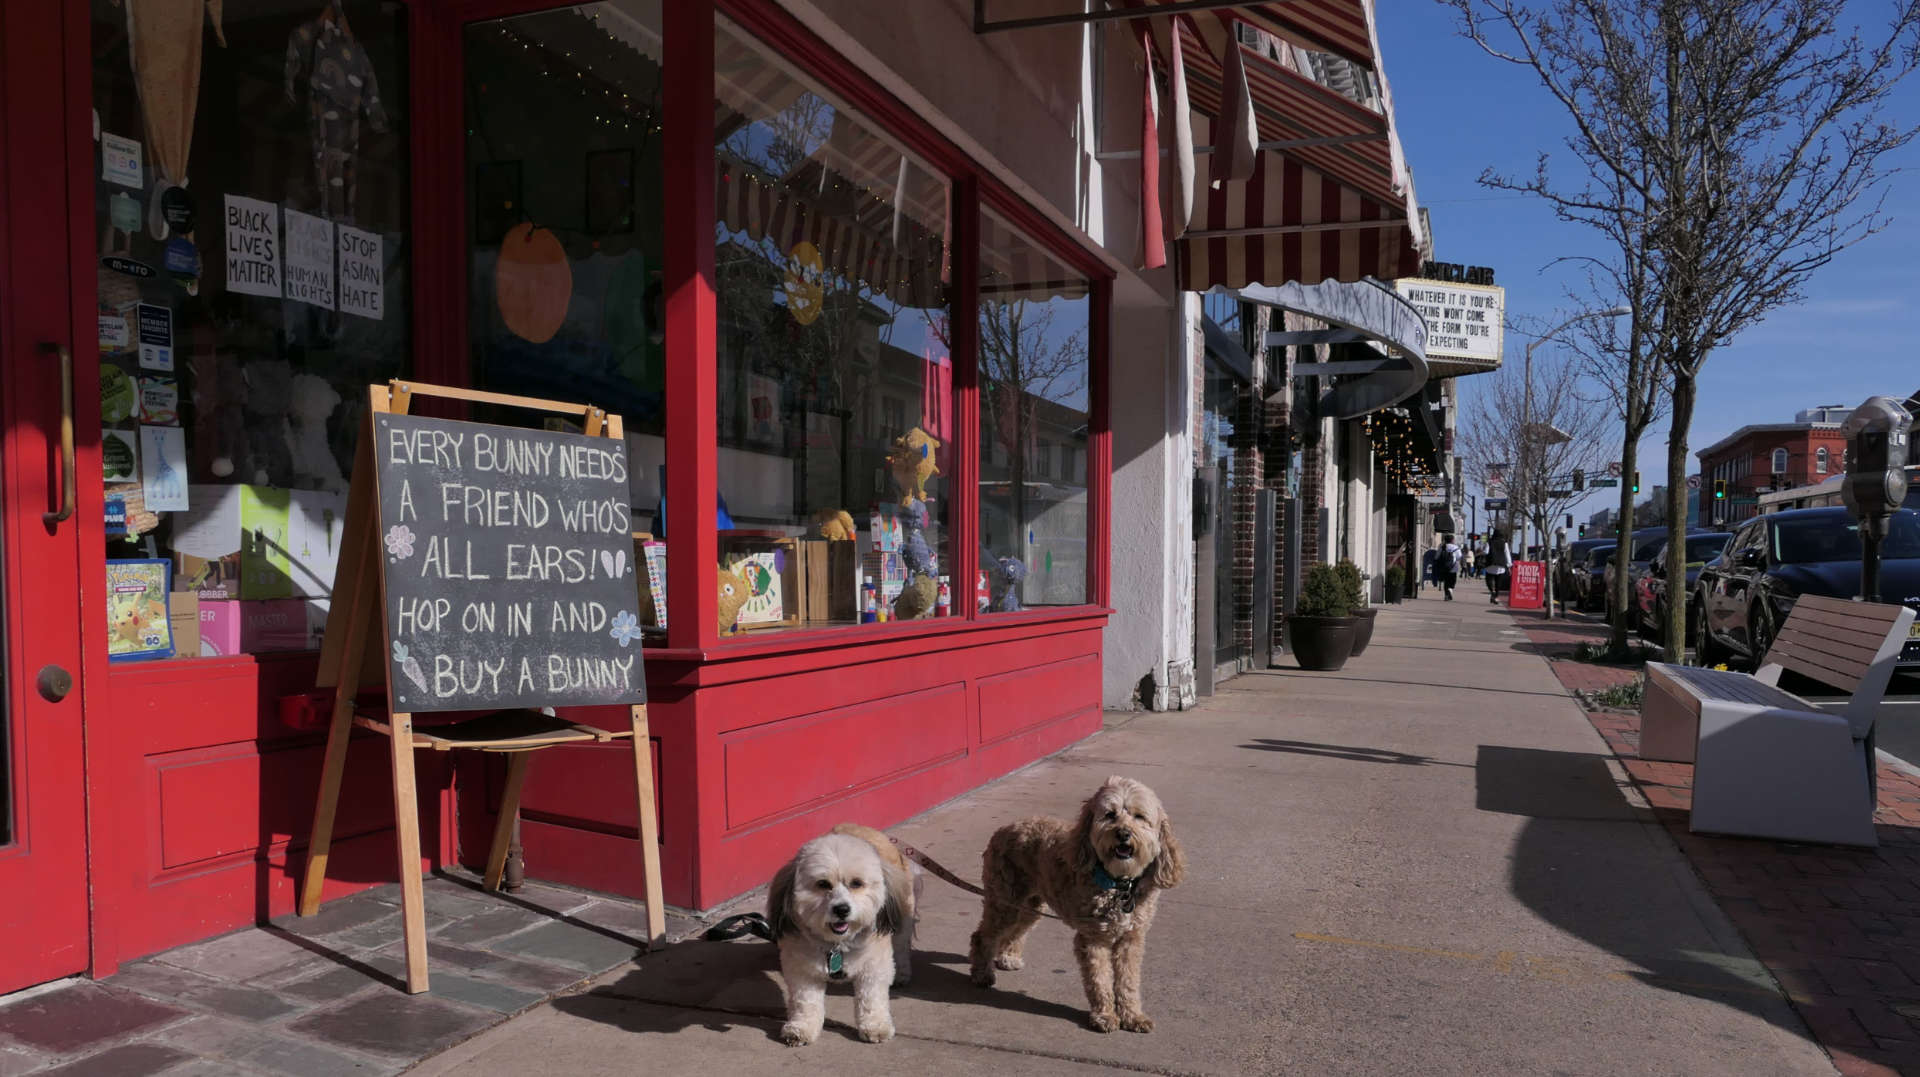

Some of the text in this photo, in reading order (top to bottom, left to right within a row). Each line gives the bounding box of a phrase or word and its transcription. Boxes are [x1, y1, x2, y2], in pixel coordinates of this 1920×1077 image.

[229, 206, 273, 235] BLACK
[229, 232, 274, 262] LIVES
[342, 232, 377, 258] STOP
[229, 258, 278, 287] MATTER
[287, 265, 328, 289] HUMAN
[342, 260, 381, 286] ASIAN
[288, 282, 333, 305] RIGHTS
[342, 283, 379, 311] HATE
[1408, 289, 1446, 305] WHATEVER
[1448, 293, 1456, 305] IT
[1459, 294, 1466, 306] IS
[1416, 304, 1440, 318] EKING
[1466, 309, 1485, 322] COME
[1426, 320, 1490, 337] THE FORM YOU'RE
[1429, 335, 1469, 350] EXPECTING
[390, 428, 627, 483] EVERY BUNNY NEEDS
[399, 479, 629, 535] A FRIEND WHO'S
[421, 534, 597, 584] ALL EARS!
[398, 596, 607, 637] HOP ON IN AND
[434, 653, 634, 698] BUY A BUNNY
